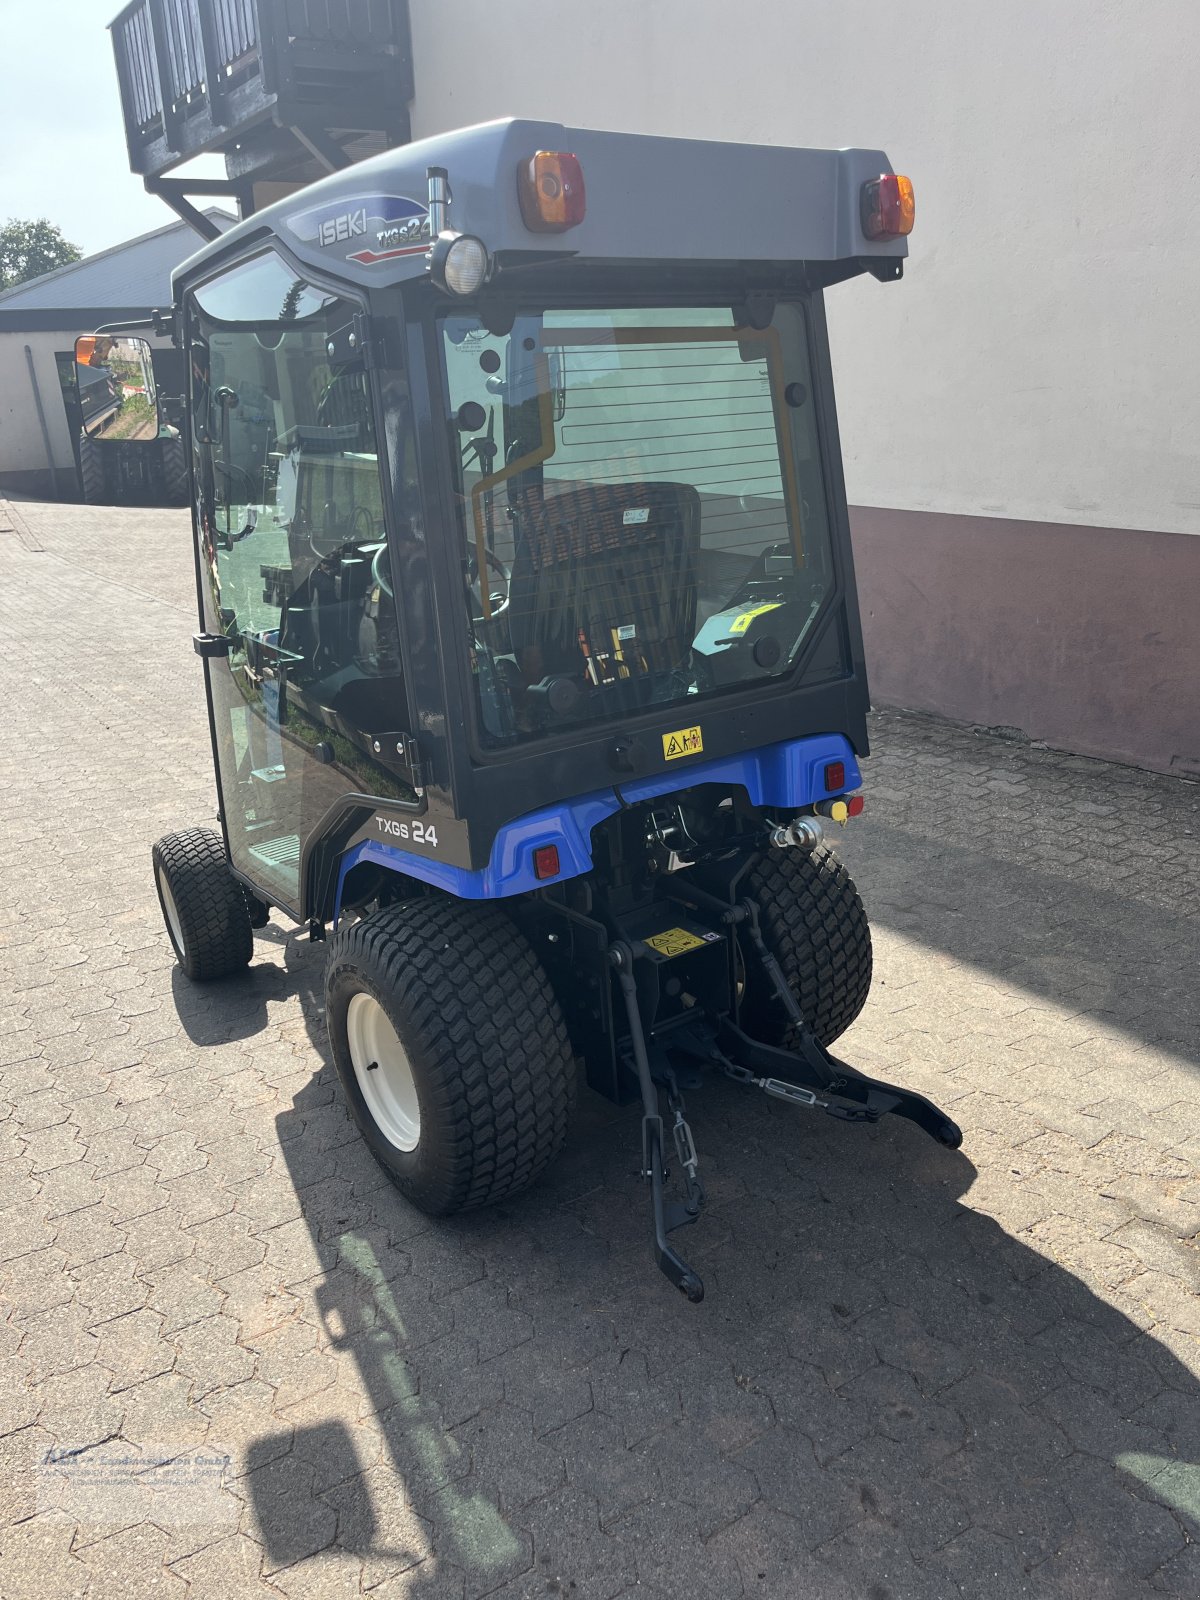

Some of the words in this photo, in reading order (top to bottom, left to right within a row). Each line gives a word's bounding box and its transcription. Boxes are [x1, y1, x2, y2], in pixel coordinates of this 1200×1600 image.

[319, 208, 367, 247] ISEKI
[375, 816, 409, 839] TXGS
[411, 820, 438, 848] 24
